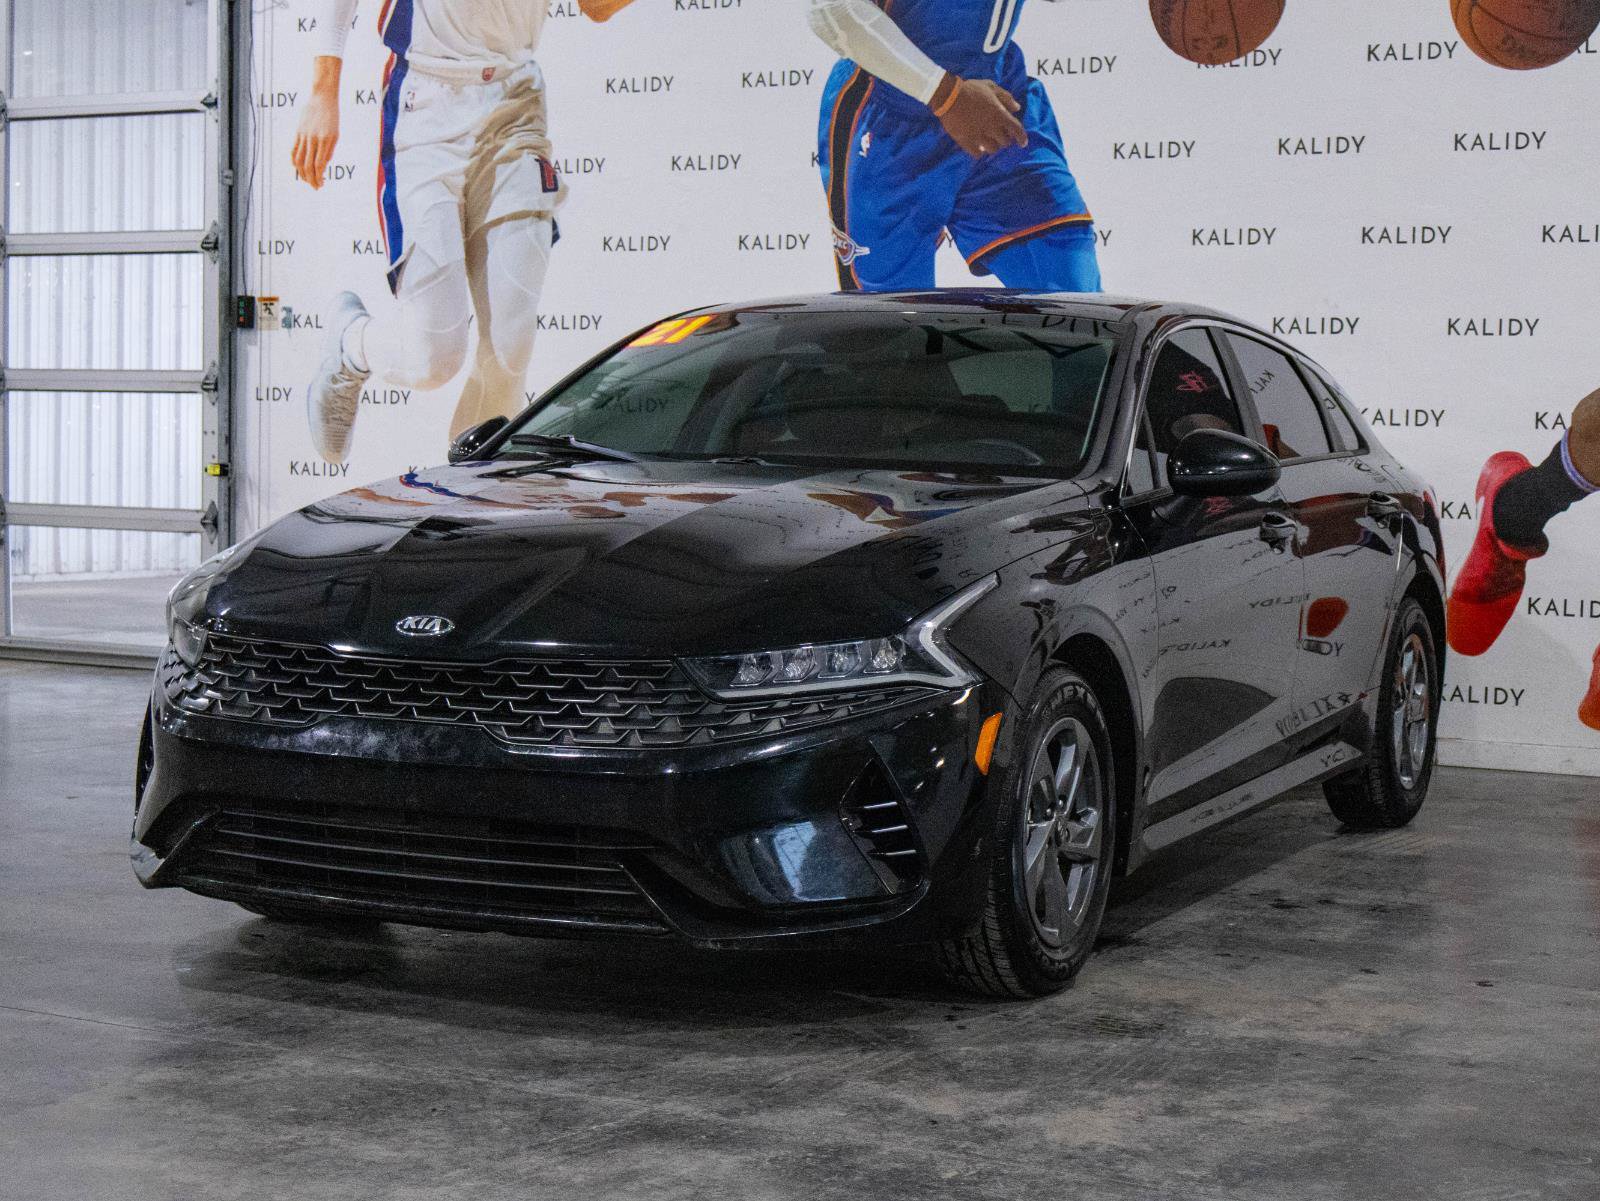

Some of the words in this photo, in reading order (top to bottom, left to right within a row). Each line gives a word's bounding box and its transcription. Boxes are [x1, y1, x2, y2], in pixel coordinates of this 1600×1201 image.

[298, 15, 359, 32] KAY
[1367, 41, 1458, 62] KALIDY
[1037, 55, 1117, 76] KALIDY
[606, 76, 674, 94] KALIDY
[742, 69, 814, 88] KALIDY
[257, 92, 298, 108] LIDY
[1278, 135, 1366, 156] KALIDY
[1454, 131, 1546, 151] KALIDY
[1113, 140, 1196, 160] KALIDY
[553, 157, 606, 174] ALIDY
[671, 154, 742, 171] KALIDY
[738, 234, 811, 250] KALIDY
[1192, 227, 1277, 246] KALIDY
[1361, 225, 1452, 244] KALIDY
[1542, 224, 1600, 243] KALI
[258, 240, 296, 255] LIDY
[353, 240, 385, 255] KAL
[603, 235, 671, 252] KALIDY
[292, 315, 324, 329] KAL
[537, 315, 602, 330] KALIDY
[1273, 317, 1360, 335] KALIDY
[1448, 318, 1540, 336] KALIDY
[256, 387, 293, 402] LIDY
[361, 389, 411, 405] ALIDY
[290, 461, 350, 477] KALIDY
[1528, 596, 1600, 618] KALID
